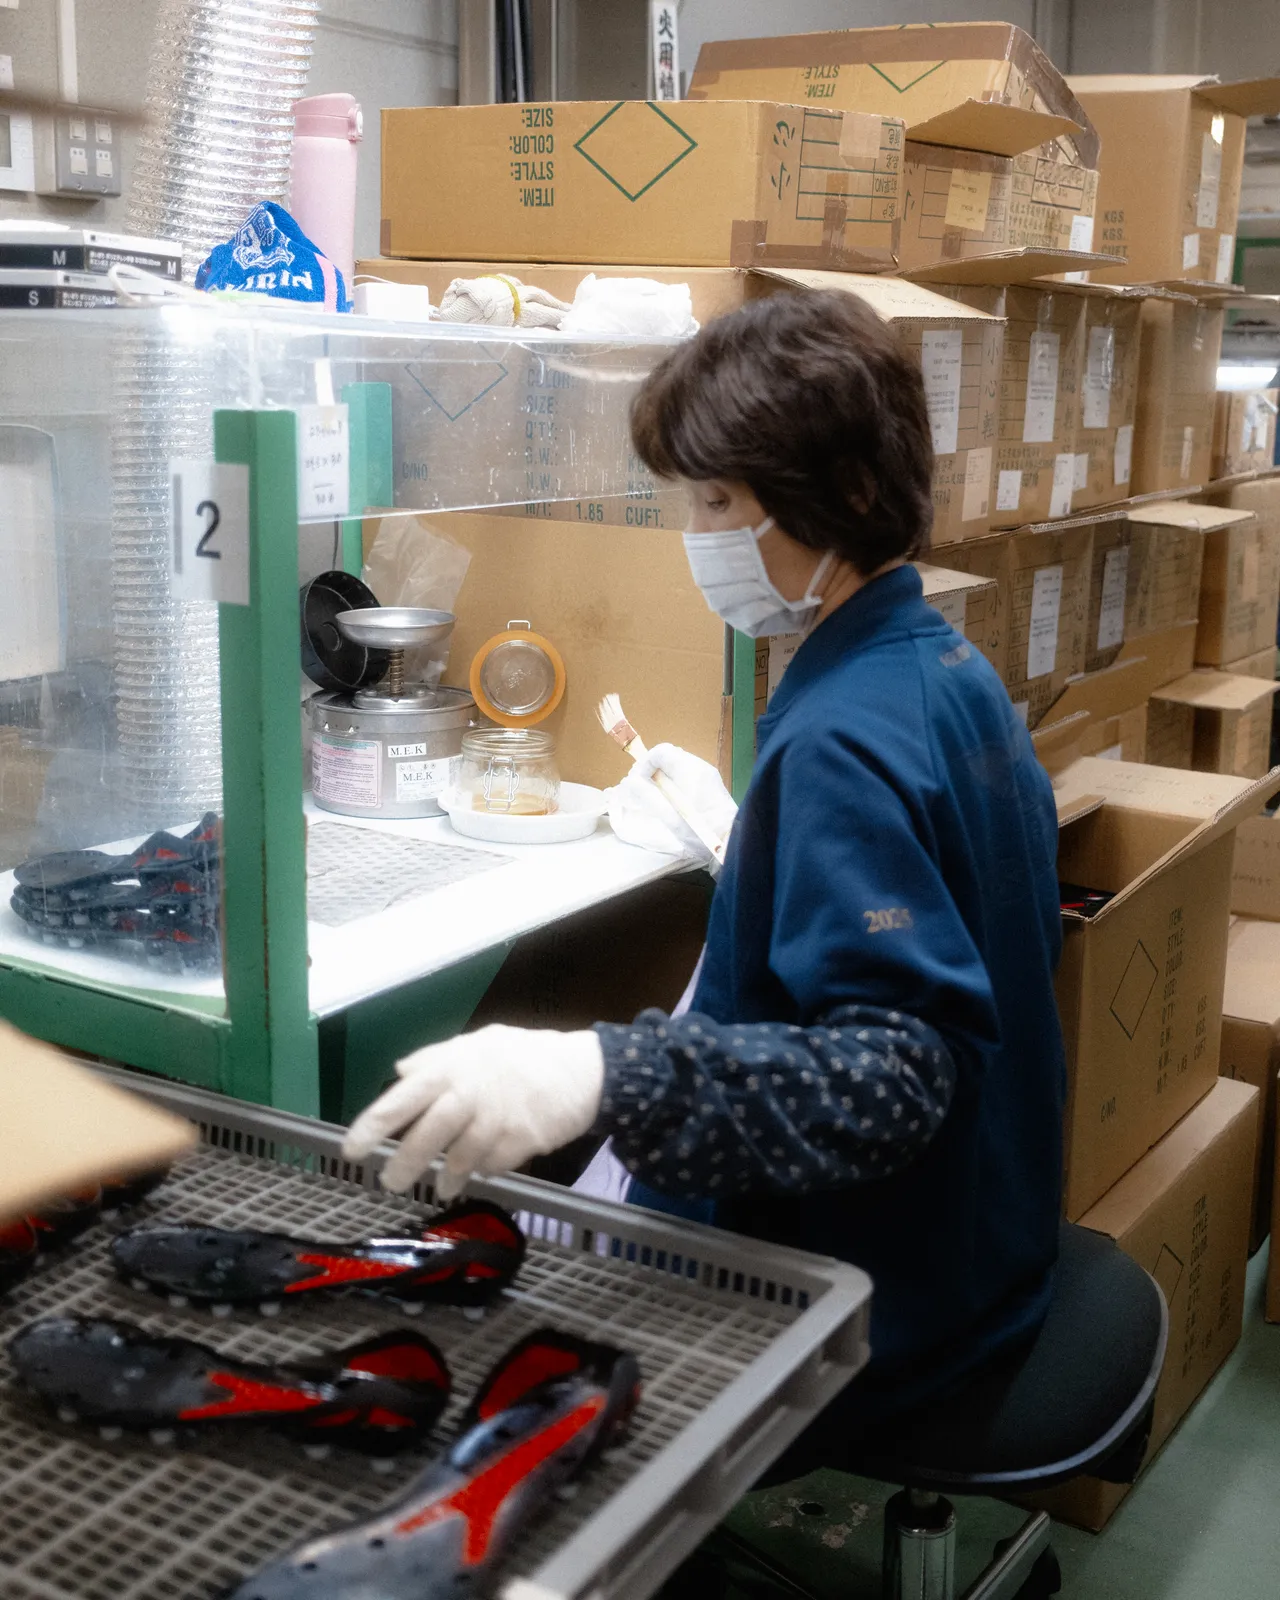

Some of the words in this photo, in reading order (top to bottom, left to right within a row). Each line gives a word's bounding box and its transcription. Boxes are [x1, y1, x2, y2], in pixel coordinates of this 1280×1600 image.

[804, 83, 836, 98] ITEM:
[521, 107, 554, 128] SIZE:
[509, 134, 555, 155] COLOR:
[510, 161, 555, 181] STYLE:
[519, 187, 555, 207] ITEM:
[52, 250, 67, 266] M
[166, 260, 177, 276] M
[28, 290, 40, 307] S
[525, 420, 558, 442] Q'TY:
[575, 502, 604, 523] 1.85
[625, 506, 664, 529] CUFT.
[195, 499, 222, 561] 2
